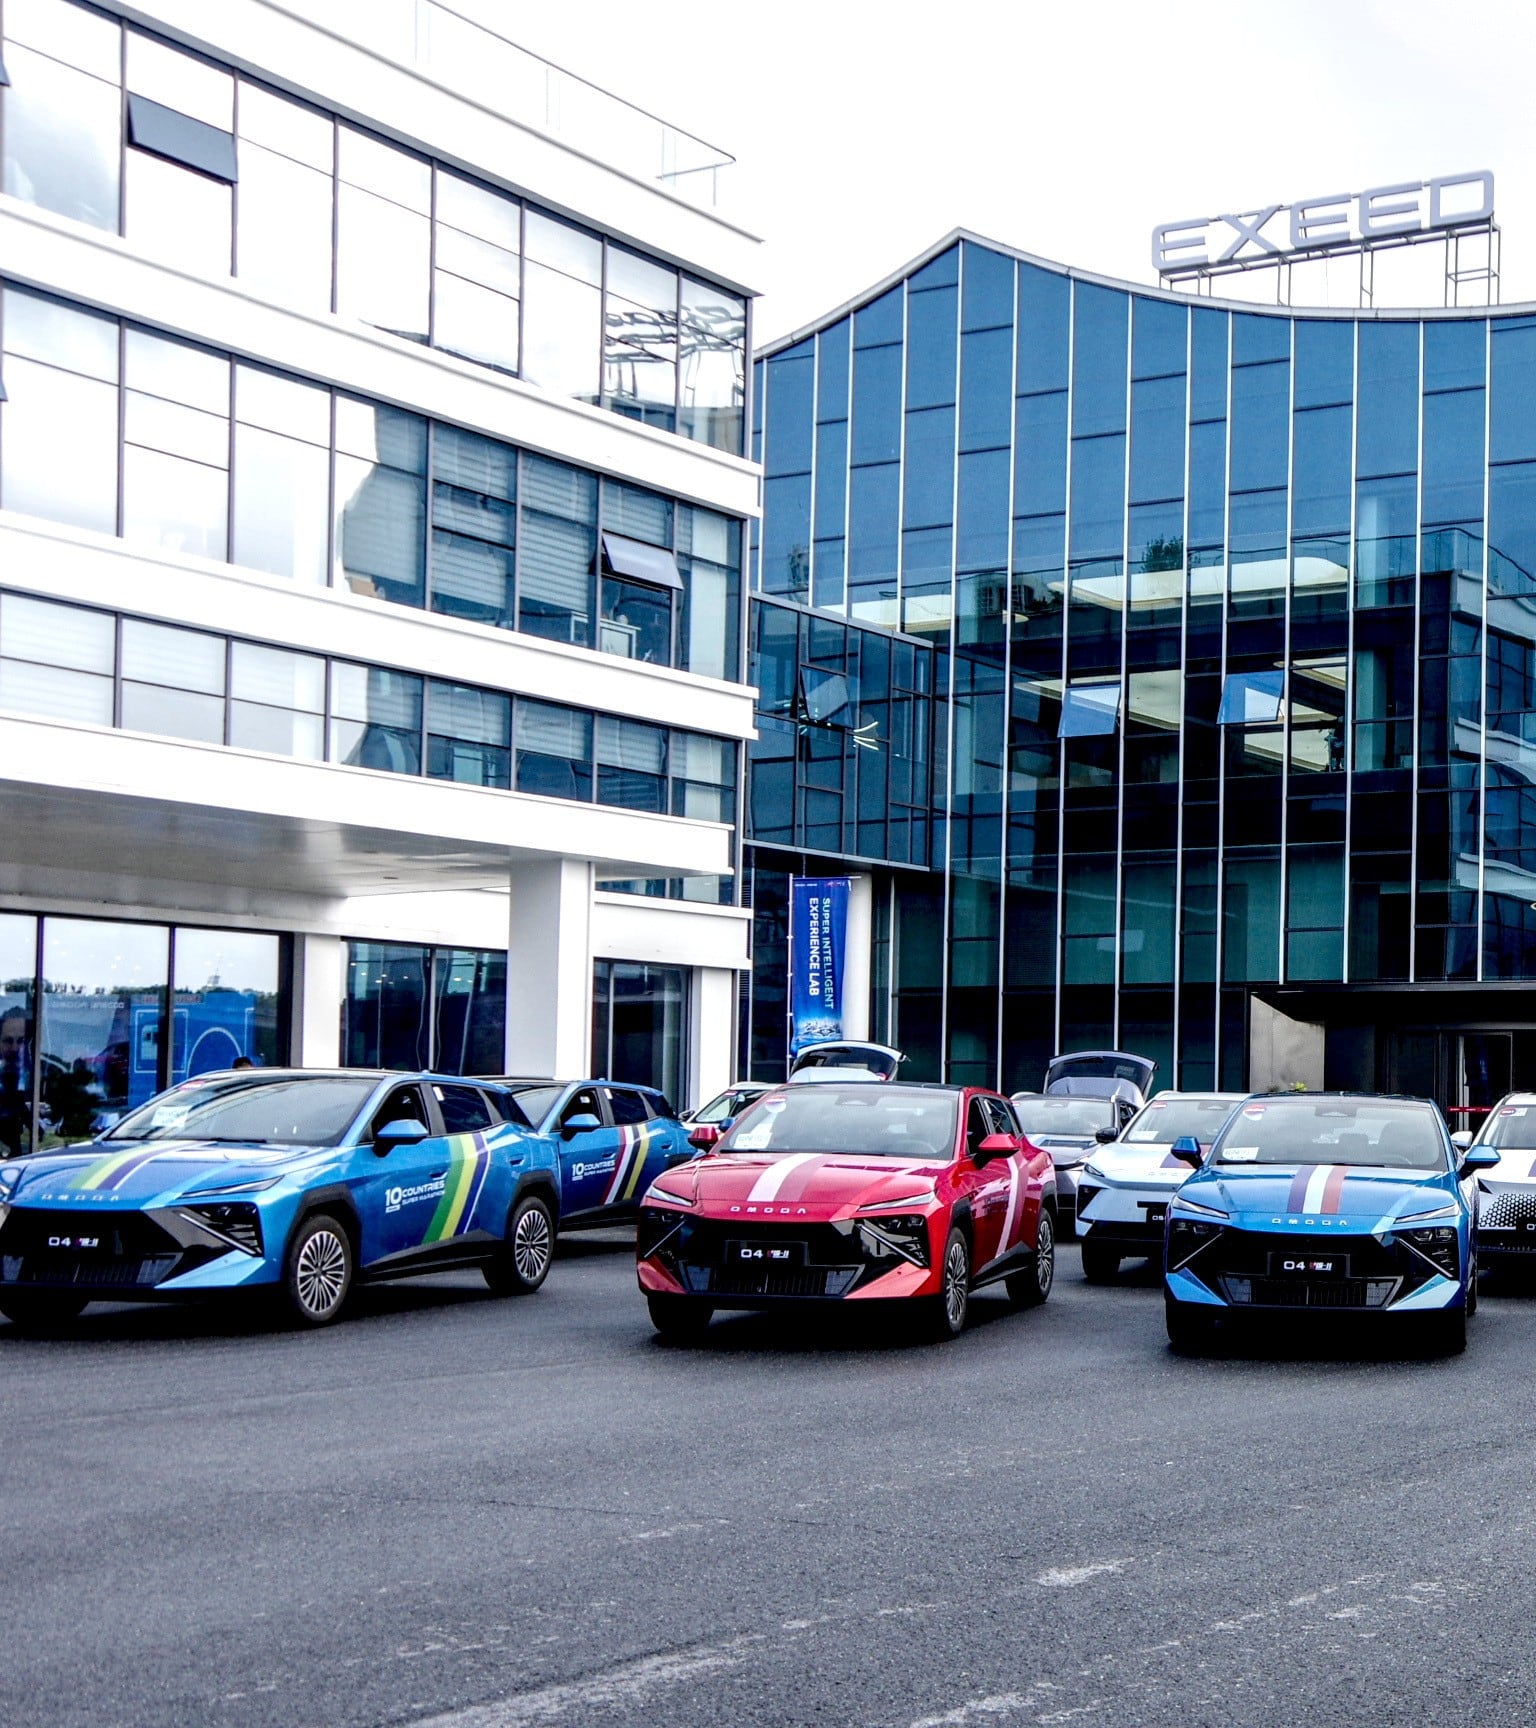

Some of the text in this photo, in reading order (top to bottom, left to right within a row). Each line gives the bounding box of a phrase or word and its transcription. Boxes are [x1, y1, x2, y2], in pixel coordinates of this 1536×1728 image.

[1151, 169, 1495, 271] EXEED
[808, 897, 820, 996] EXPERIENCE LAB
[822, 897, 834, 1009] SUPER INTELLIGENT
[572, 1162, 584, 1177] 10
[384, 1180, 446, 1207] 10 COUNTRIES
[730, 1206, 806, 1214] OMODA
[1271, 1218, 1348, 1226] OMODA
